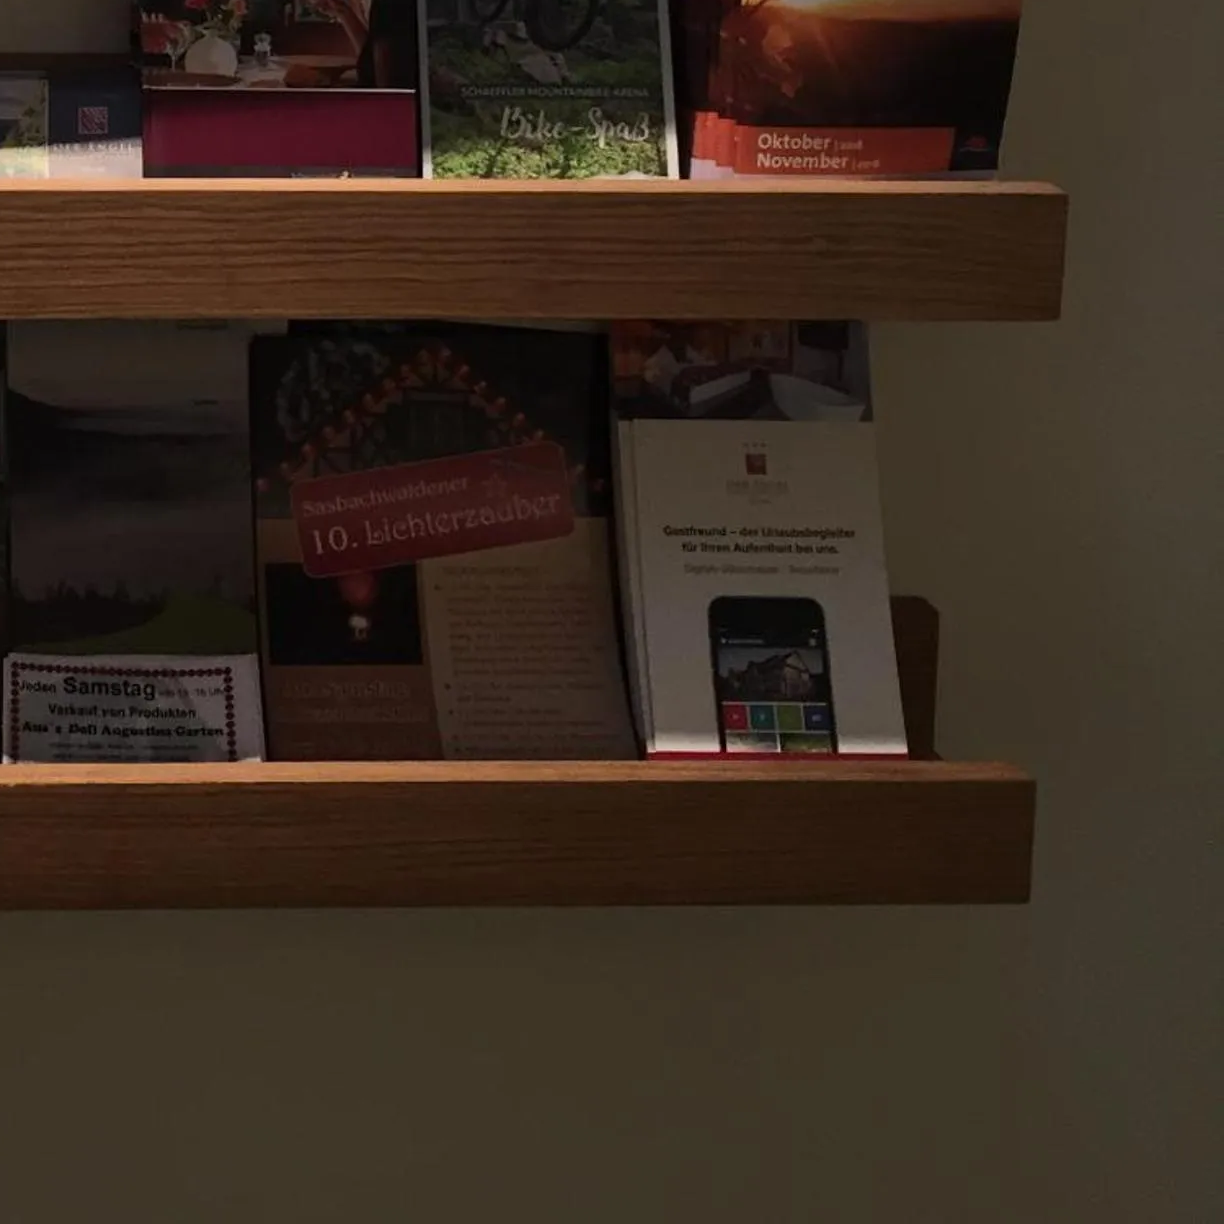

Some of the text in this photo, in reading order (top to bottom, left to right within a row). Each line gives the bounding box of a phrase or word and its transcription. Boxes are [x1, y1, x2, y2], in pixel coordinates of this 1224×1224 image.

[757, 132, 831, 151] Oktober
[756, 152, 849, 170] November
[311, 492, 561, 556] 10. Lichterzauber
[63, 676, 156, 701] Samstag
[129, 706, 197, 720] Produkten
